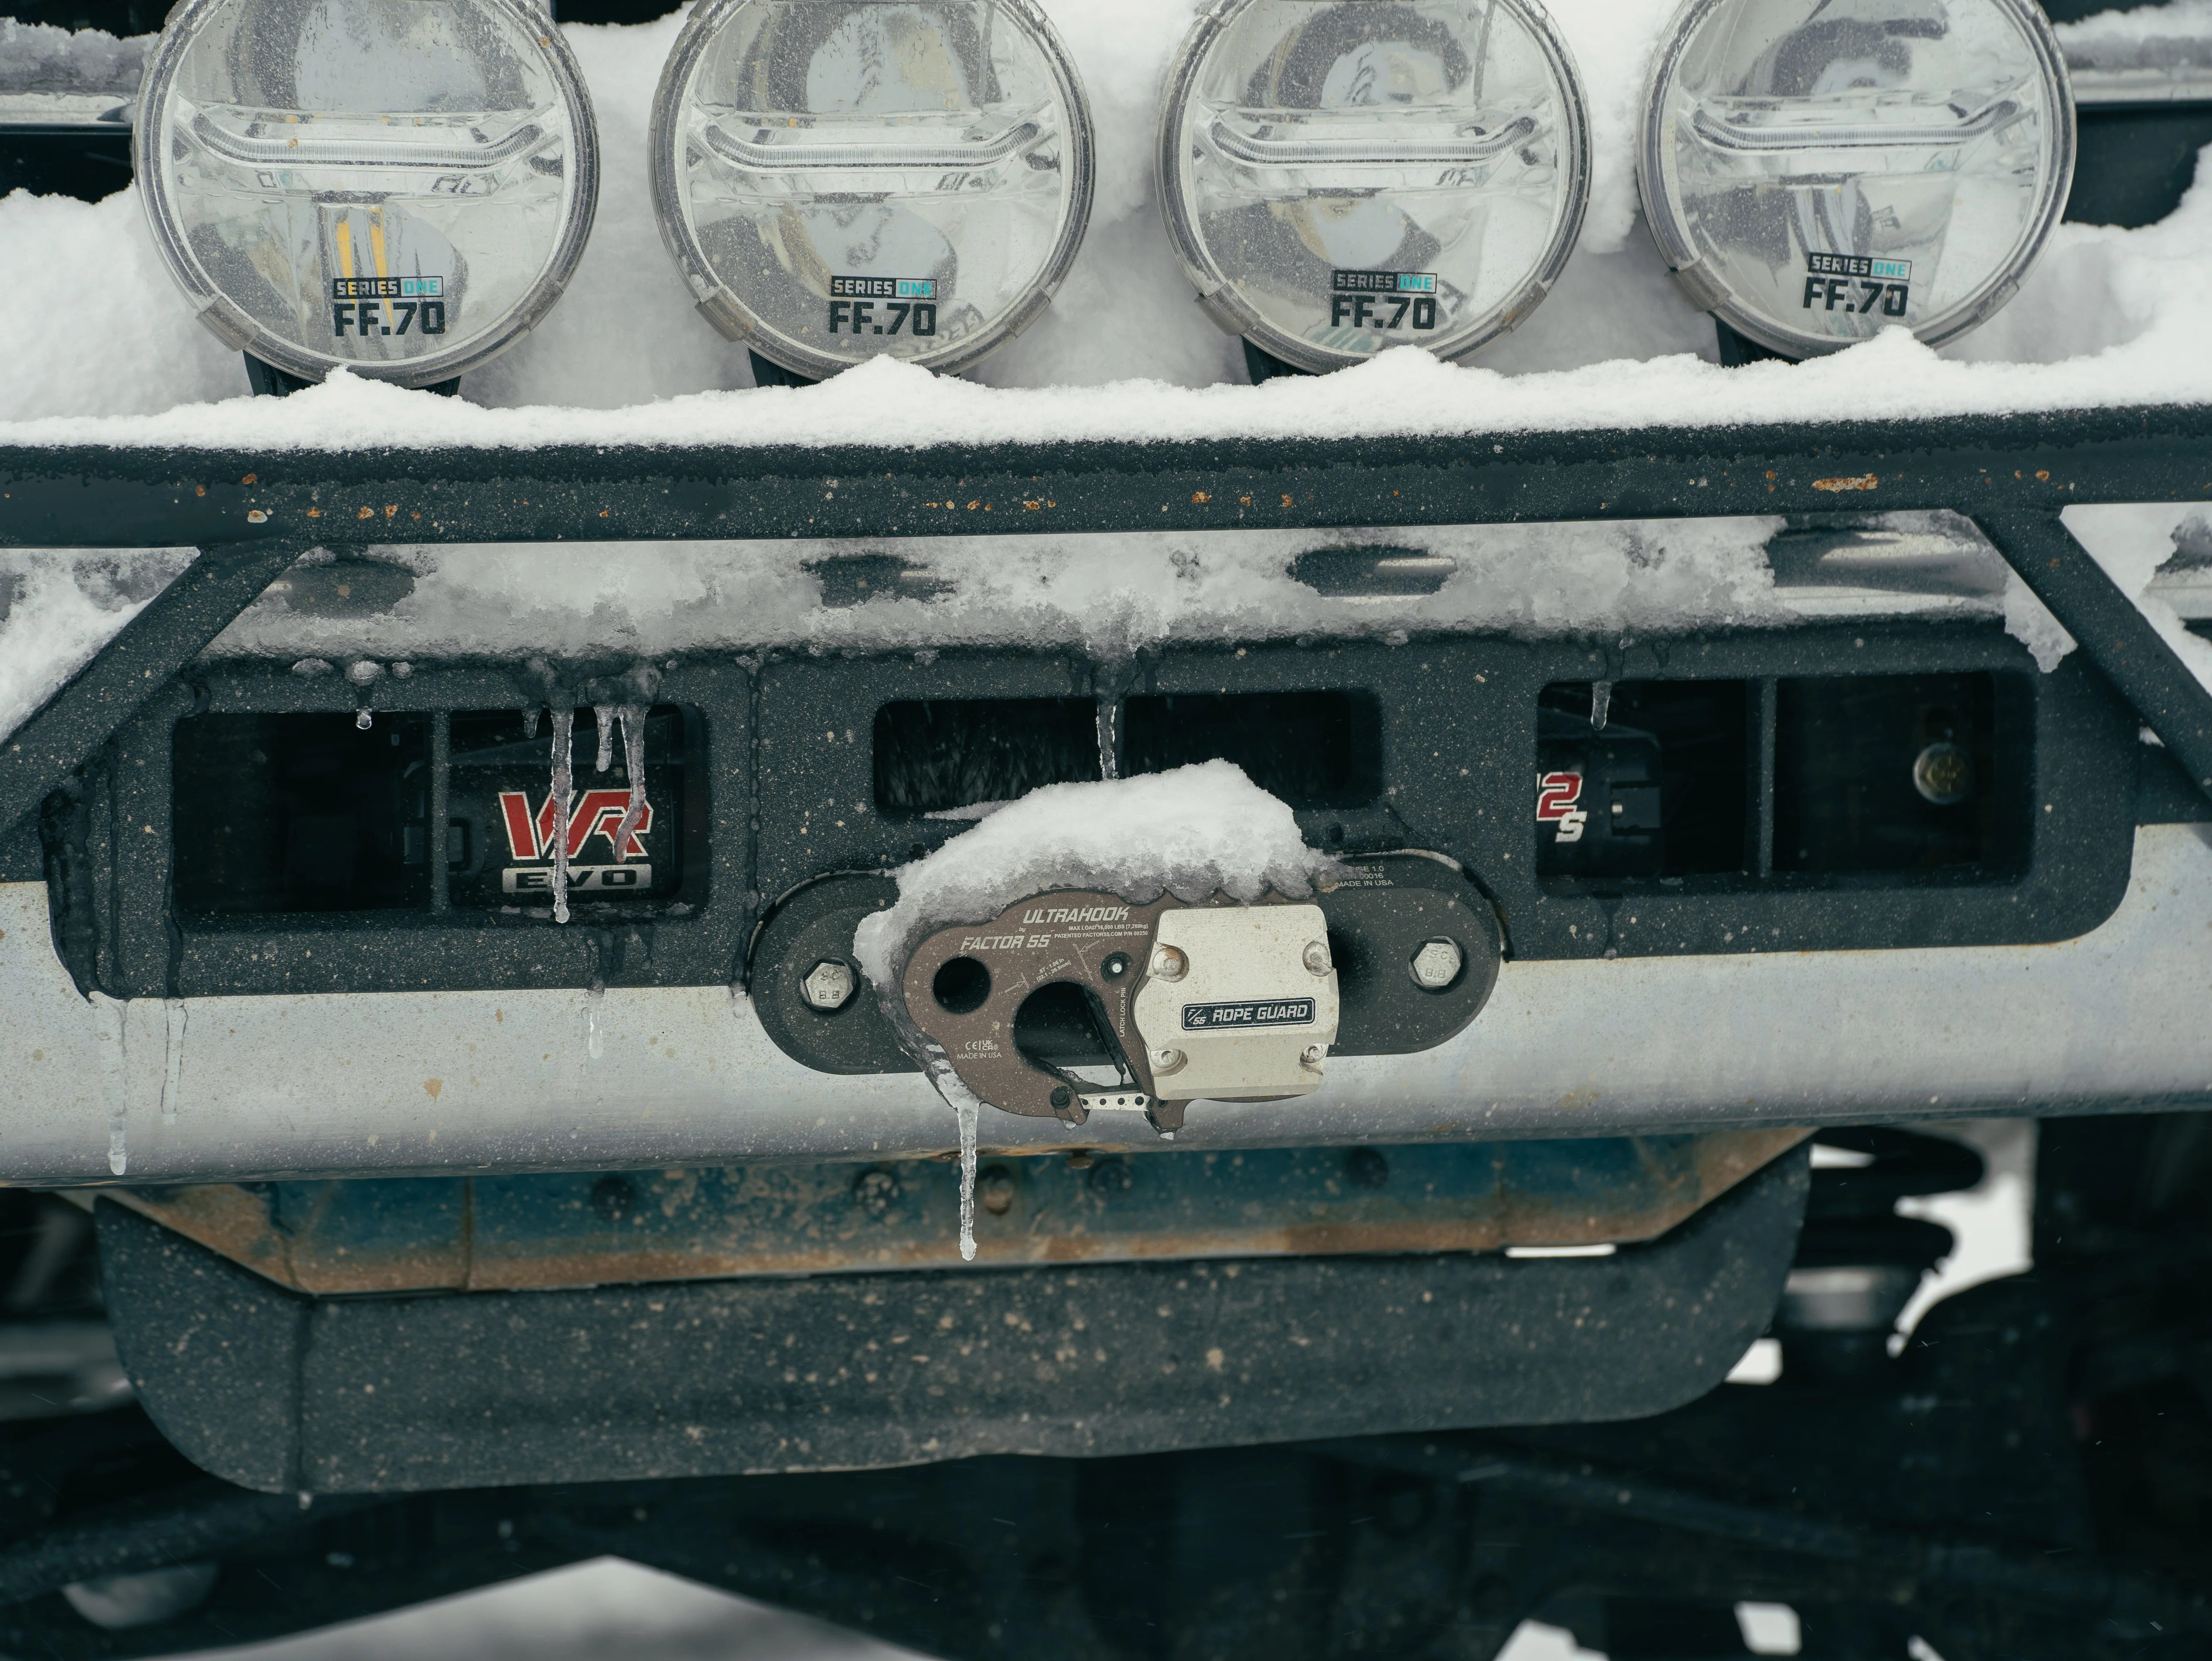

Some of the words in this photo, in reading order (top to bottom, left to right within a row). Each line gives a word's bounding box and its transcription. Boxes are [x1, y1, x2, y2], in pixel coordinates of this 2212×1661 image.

[1811, 255, 1868, 274] SERIES
[1874, 262, 1907, 277] ONE
[337, 281, 398, 295] SERIES
[404, 280, 438, 294] ONE
[834, 280, 893, 295] SERIES
[900, 282, 932, 296] ONE
[1337, 274, 1394, 289] SERIES
[1400, 276, 1432, 289] ONE
[1803, 277, 1909, 316] FF.70
[334, 301, 445, 336] FF.70
[830, 301, 937, 336] FF.70
[1331, 294, 1436, 329] FF.70
[1537, 772, 1583, 821] 2
[516, 869, 637, 889] EVO
[1023, 906, 1130, 924] ULTRAHOOK
[960, 936, 1025, 951] FACTOR
[1026, 935, 1052, 948] 55
[1036, 972, 1048, 982] [22.1
[1051, 960, 1072, 974] 26.9mm]
[1212, 1008, 1253, 1022] ROPE
[1257, 1004, 1308, 1019] GUARD
[965, 1041, 977, 1050] CE
